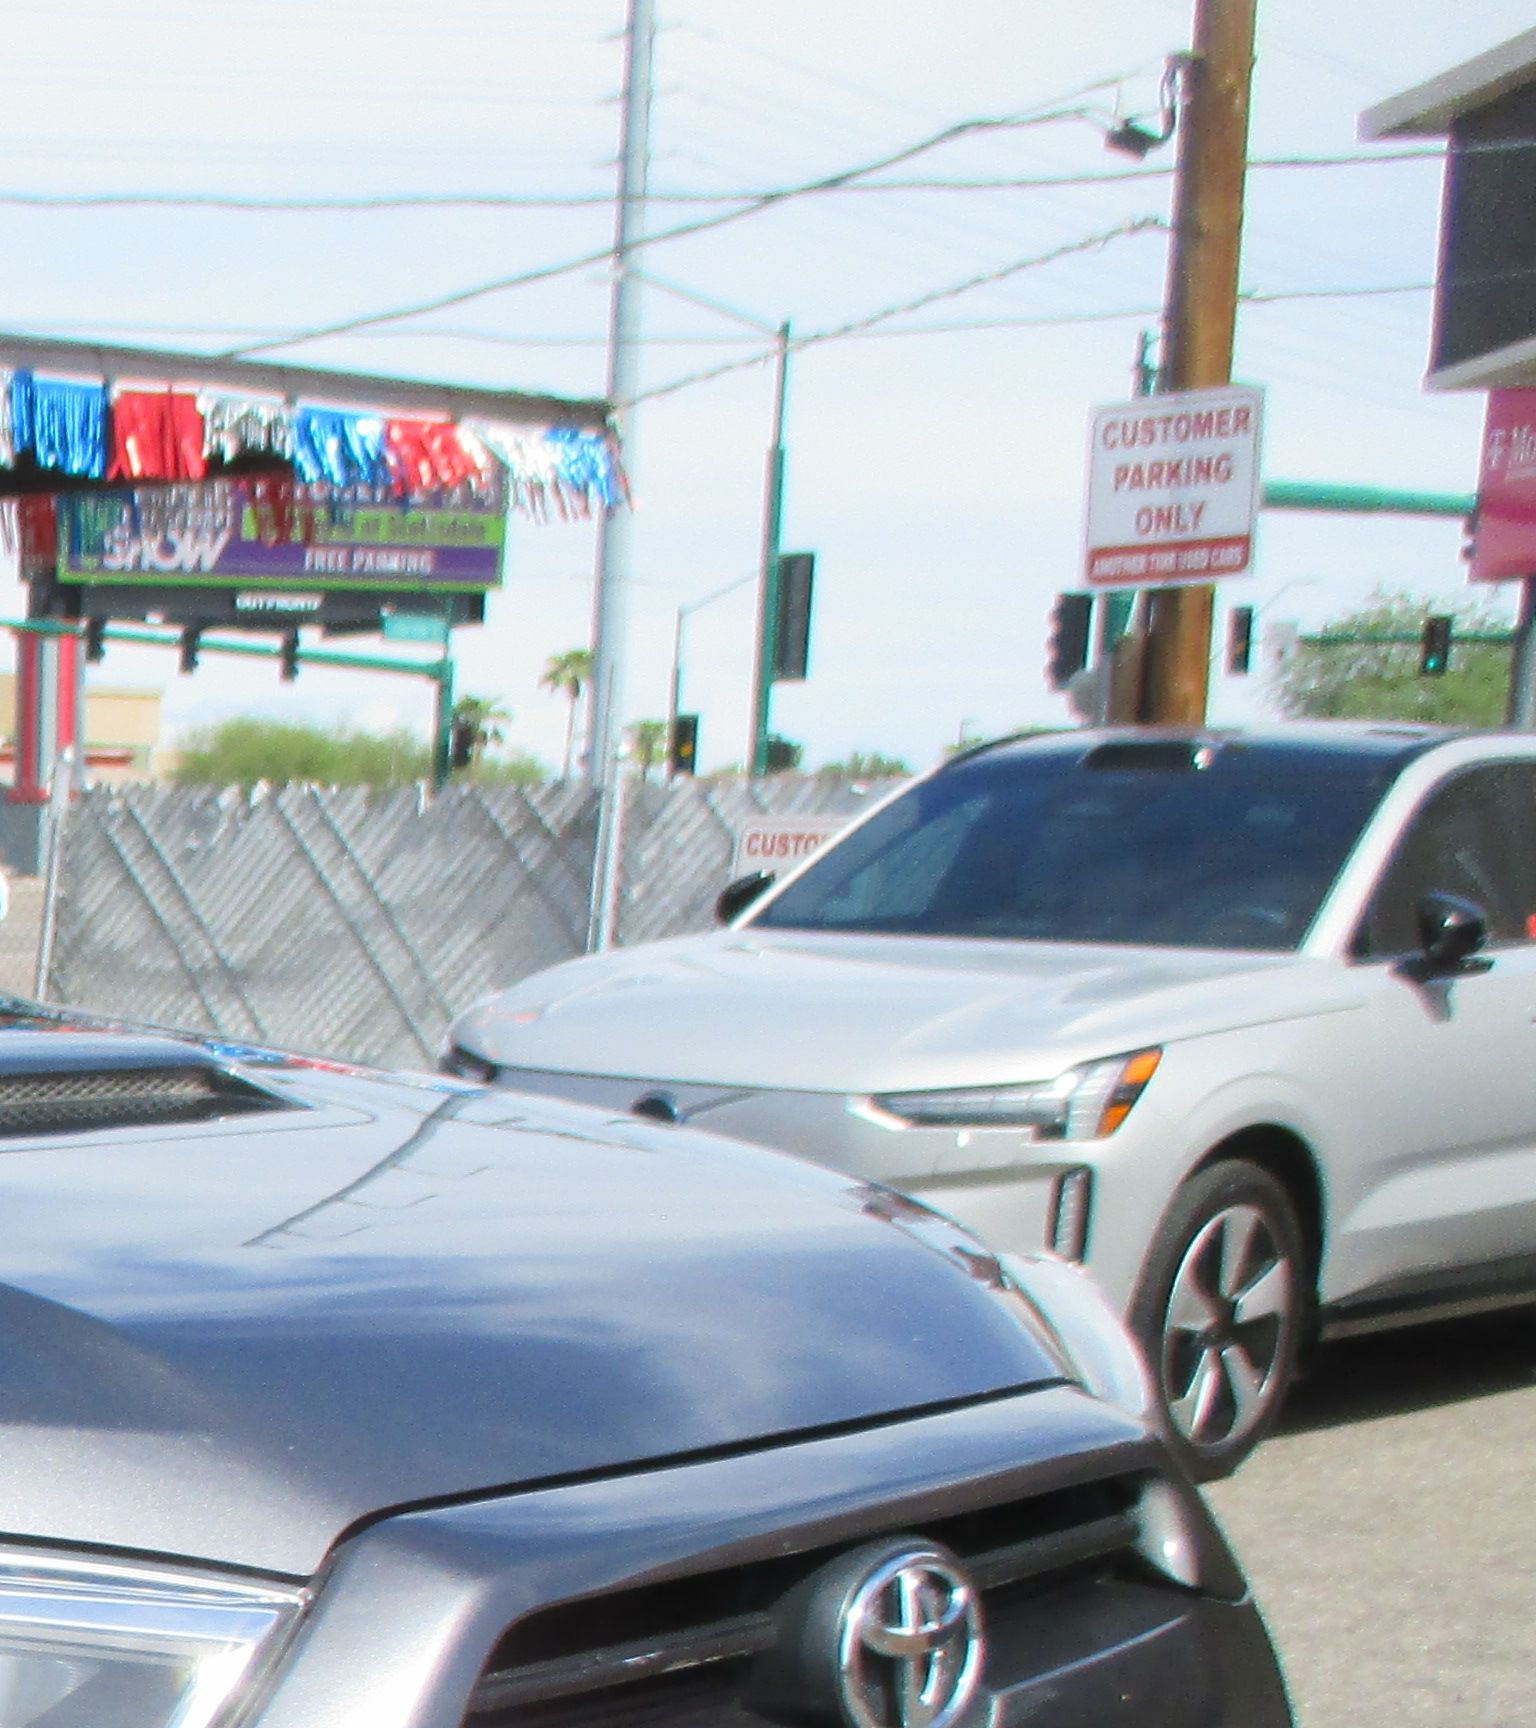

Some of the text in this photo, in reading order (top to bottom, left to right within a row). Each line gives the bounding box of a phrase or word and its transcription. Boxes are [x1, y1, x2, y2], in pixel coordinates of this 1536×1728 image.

[1103, 407, 1250, 450] CUSTOMER
[1114, 453, 1232, 492] PARKING
[1135, 501, 1205, 537] ONLY
[747, 833, 827, 857] CUSTO
